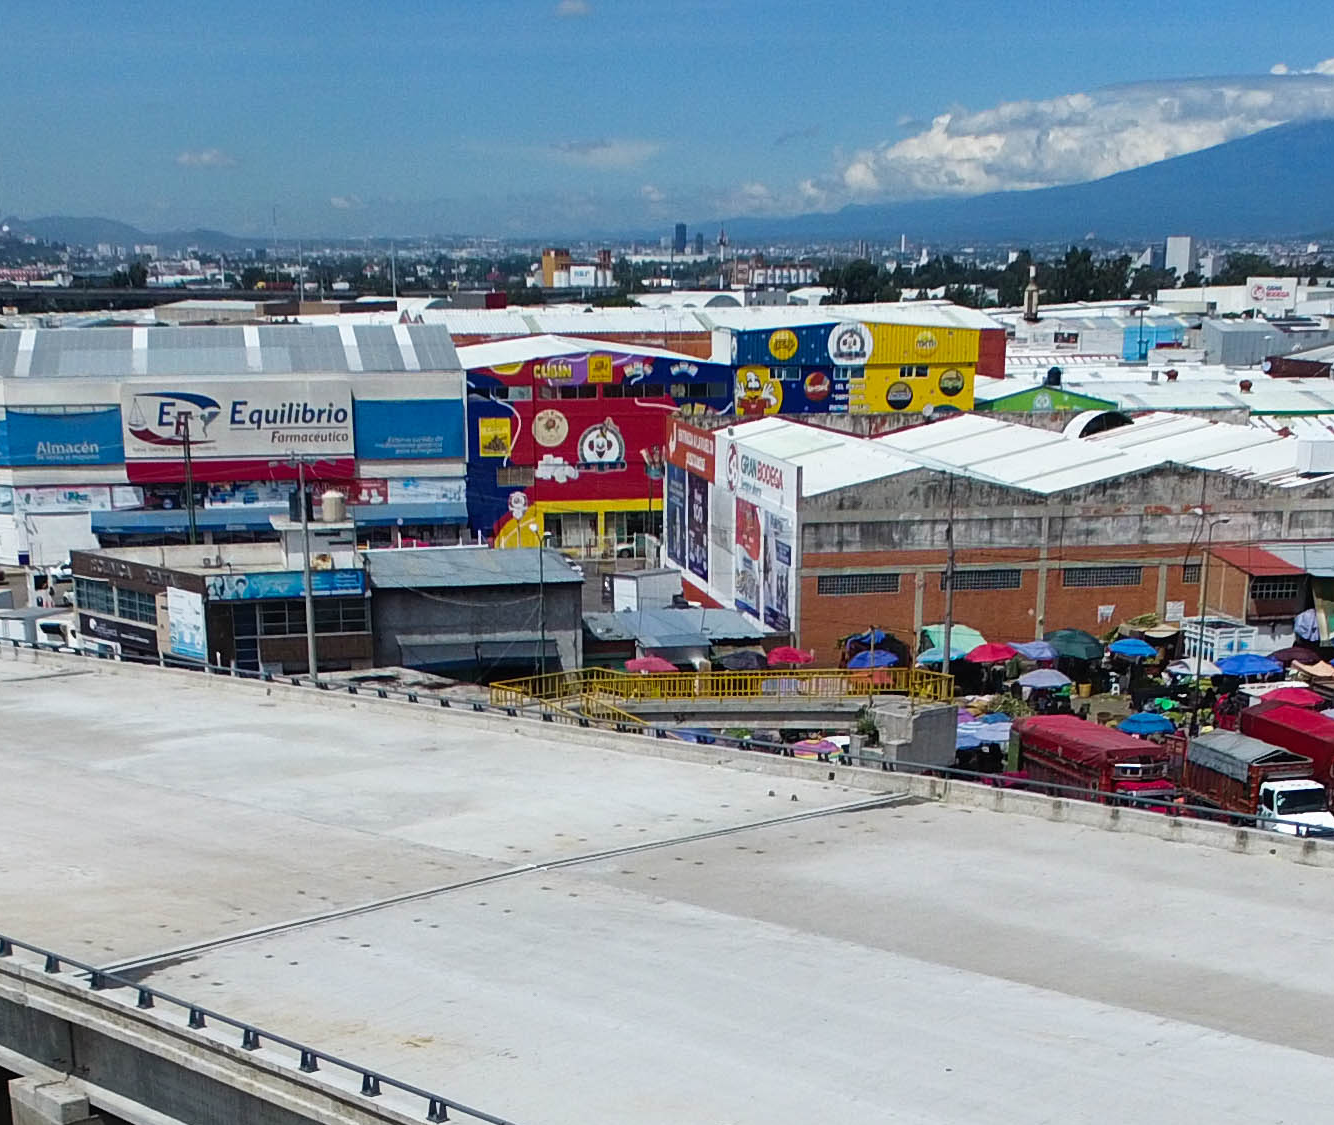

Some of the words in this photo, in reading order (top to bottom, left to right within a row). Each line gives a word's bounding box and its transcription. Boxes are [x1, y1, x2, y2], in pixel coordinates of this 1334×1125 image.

[230, 401, 348, 430] Equilibrio
[36, 440, 100, 454] Almacén
[271, 431, 349, 444] Farmacéutico
[740, 454, 757, 479] GRAN
[757, 460, 784, 491] BODEGA
